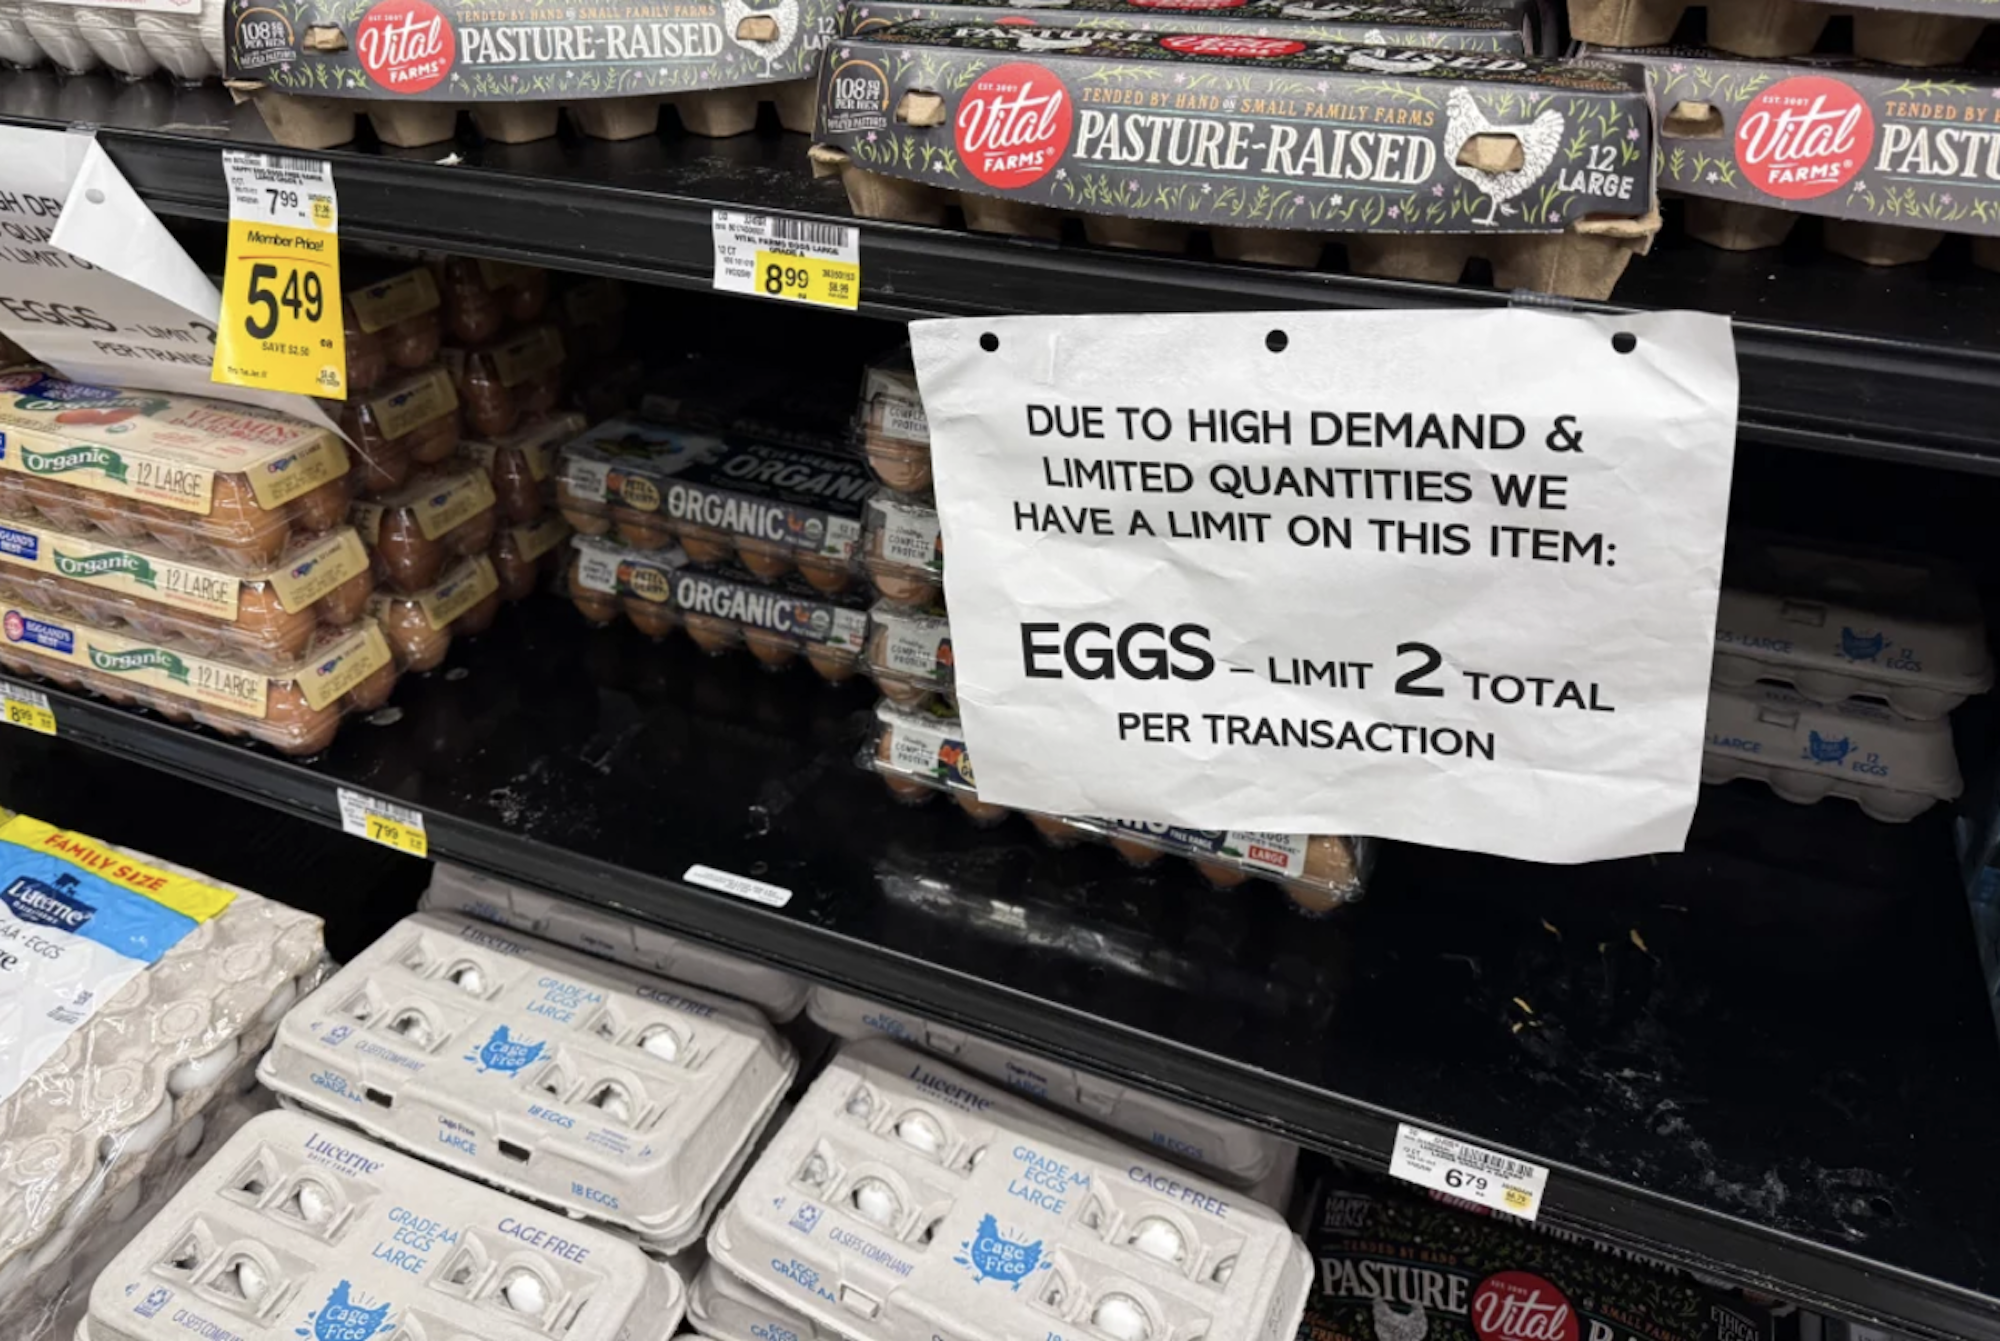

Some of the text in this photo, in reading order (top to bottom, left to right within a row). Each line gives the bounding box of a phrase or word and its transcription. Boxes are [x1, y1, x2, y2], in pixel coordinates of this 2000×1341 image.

[457, 4, 716, 23] TENDED BY HAND SMALL FAMILY FARMS
[816, 16, 834, 35] 12
[241, 21, 271, 40] 108
[360, 11, 442, 70] Vital
[459, 21, 724, 65] PASTURE-RAISED
[835, 77, 867, 100] 108
[835, 99, 879, 111] PER HEN
[959, 80, 1063, 153] Vital
[1083, 88, 1435, 127] TENDED BY HAND SMALL FAMILY FARMS
[1884, 100, 1989, 122] TENDED BY
[1739, 94, 1864, 164] Vital
[1072, 109, 1437, 185] PASTURE-RAISED
[1586, 144, 1618, 172] 12
[1558, 167, 1635, 200] LARGE
[247, 230, 291, 247] Member
[734, 234, 757, 245] VITAL
[758, 237, 786, 249] FARMS
[4, 246, 68, 269] LIMIT
[0, 296, 198, 344] EGGS LIMIT
[92, 339, 141, 359] PER
[261, 340, 287, 355] SAVE
[1026, 404, 1584, 453] DUE TO HIGH DEMAND &
[27, 446, 111, 471] Organic
[136, 461, 153, 486] 12
[154, 468, 202, 498] LARGE
[1043, 456, 1568, 510] LIMITED QUANTITIES WE
[667, 484, 786, 542] ORGANIC
[888, 533, 930, 551] COMPLETE
[1014, 501, 1616, 567] HAVE A LIMIT ON THIS ITEM:
[60, 554, 140, 574] Organic
[891, 545, 926, 560] PROTEIN
[165, 567, 229, 605] 12 LARGE
[676, 576, 793, 633] ORGANIC
[94, 649, 173, 669] Organic
[893, 654, 928, 669] PROTEIN
[1020, 622, 1615, 712] EGGS LIMIT 2 TOTAL
[1886, 658, 1923, 673] EGGS
[197, 665, 259, 702] 12 LARGE
[1118, 712, 1494, 761] PER TRANSACTION
[1712, 734, 1763, 754] LARGE
[897, 751, 930, 767] PROTEIN
[1851, 761, 1889, 777] EGGS
[1865, 752, 1880, 764] 12
[1169, 829, 1214, 850] FREE RANGE
[44, 833, 169, 892] FAMILY SIZE
[1250, 847, 1287, 866] LARGE
[7, 878, 88, 927] Lucerne
[24, 934, 67, 961] EGGS
[537, 975, 602, 1005] GRADE AA
[543, 988, 580, 1011] EGGS
[634, 983, 681, 1009] CAGE
[525, 1000, 576, 1024] LARGE
[489, 1040, 529, 1058] Cage
[527, 1103, 576, 1129] 18 EGGS
[438, 1130, 478, 1156] LARGE
[1012, 1144, 1091, 1190] GRADE AA
[1023, 1166, 1070, 1195] EGGS
[571, 1181, 619, 1210] 18 EGGS
[1007, 1179, 1068, 1215] LARGE
[1127, 1165, 1230, 1220] CAGE FREE
[1324, 1196, 1372, 1214] HAPPY
[387, 1205, 461, 1245] GRADE AA
[391, 1226, 436, 1253] EGGS
[497, 1216, 590, 1265] CAGE FREE
[980, 1238, 1026, 1261] Cage
[371, 1241, 428, 1275] LARGE
[790, 1258, 820, 1283] EGGS
[862, 1243, 915, 1278] COMPLIANT
[984, 1256, 1027, 1275] Free
[771, 1257, 837, 1304] GRADE AA
[1319, 1256, 1470, 1316] PASTURE
[325, 1305, 371, 1327] Cage
[1475, 1289, 1568, 1341] Vital
[1600, 1302, 1643, 1329] SMALL
[325, 1323, 367, 1341] Free
